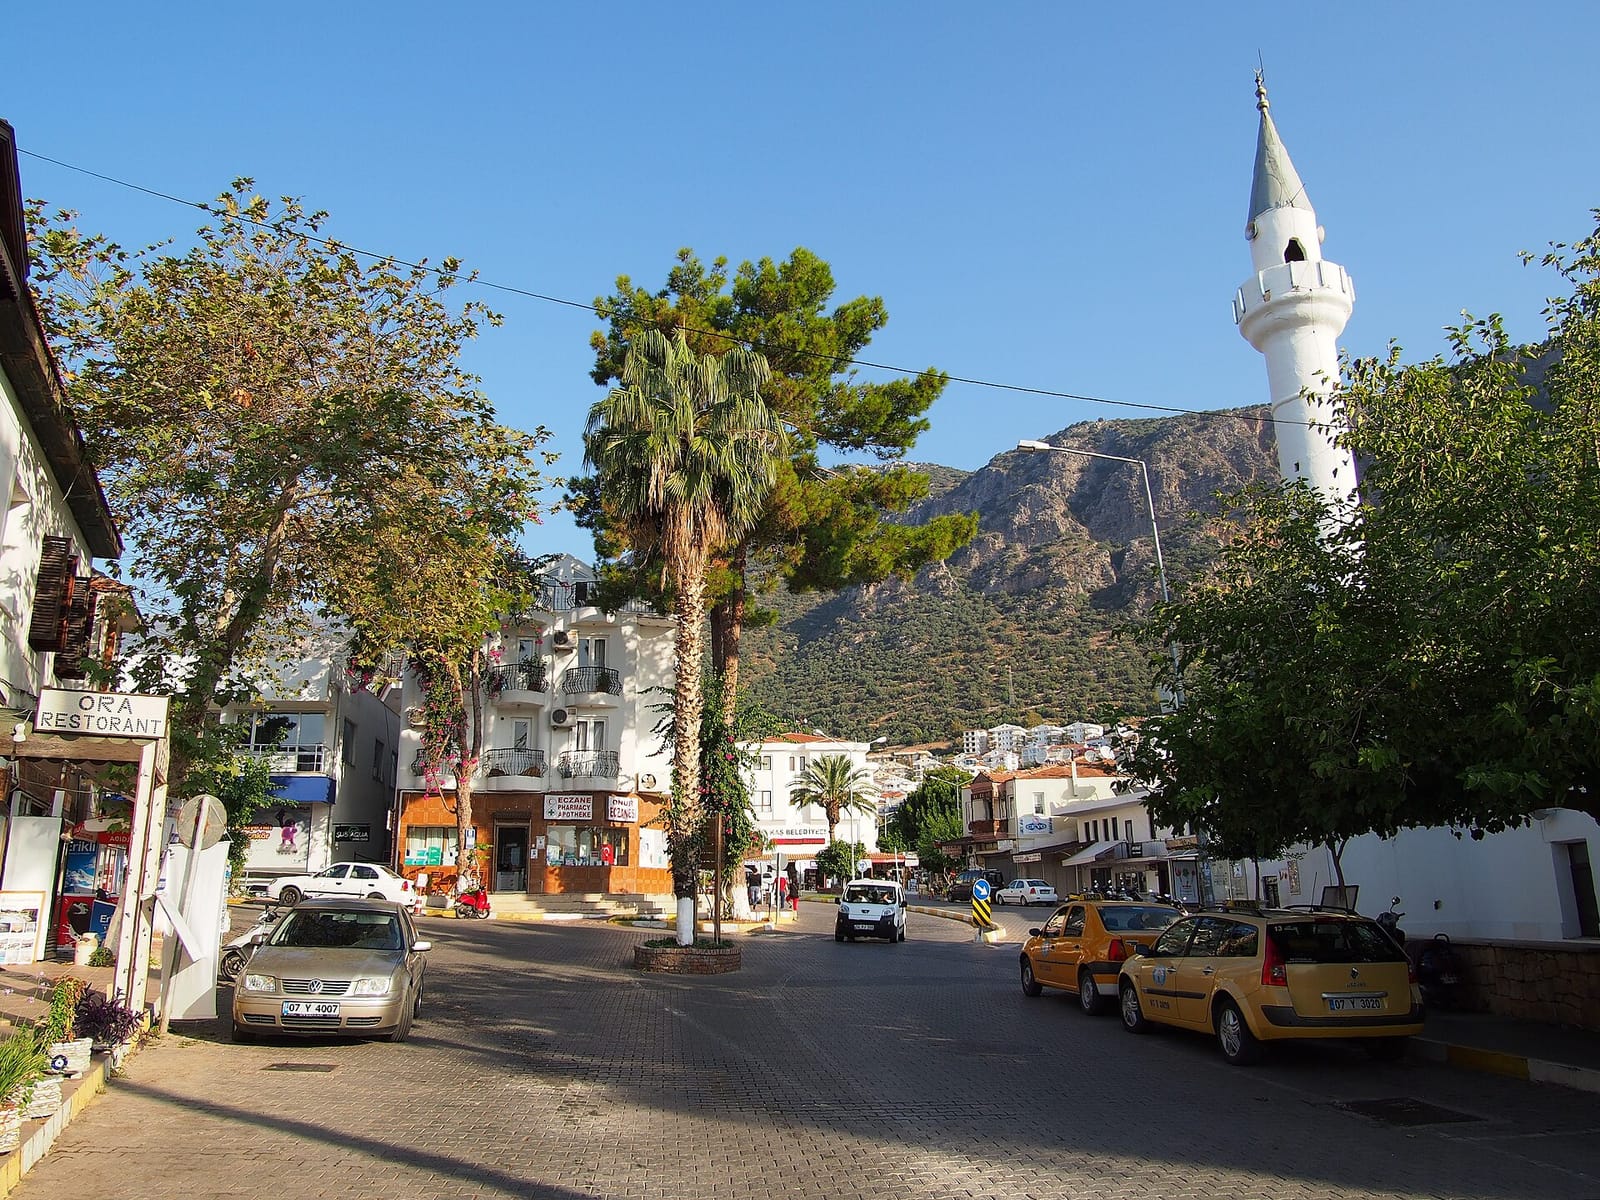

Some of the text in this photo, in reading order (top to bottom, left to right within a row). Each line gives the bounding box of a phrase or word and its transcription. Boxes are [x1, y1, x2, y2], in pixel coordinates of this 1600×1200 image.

[79, 695, 133, 714] ORA
[40, 711, 161, 734] RESTORANT
[289, 1003, 338, 1013] 07 Y 4007
[1335, 999, 1345, 1009] 07
[1360, 999, 1381, 1009] 3020
